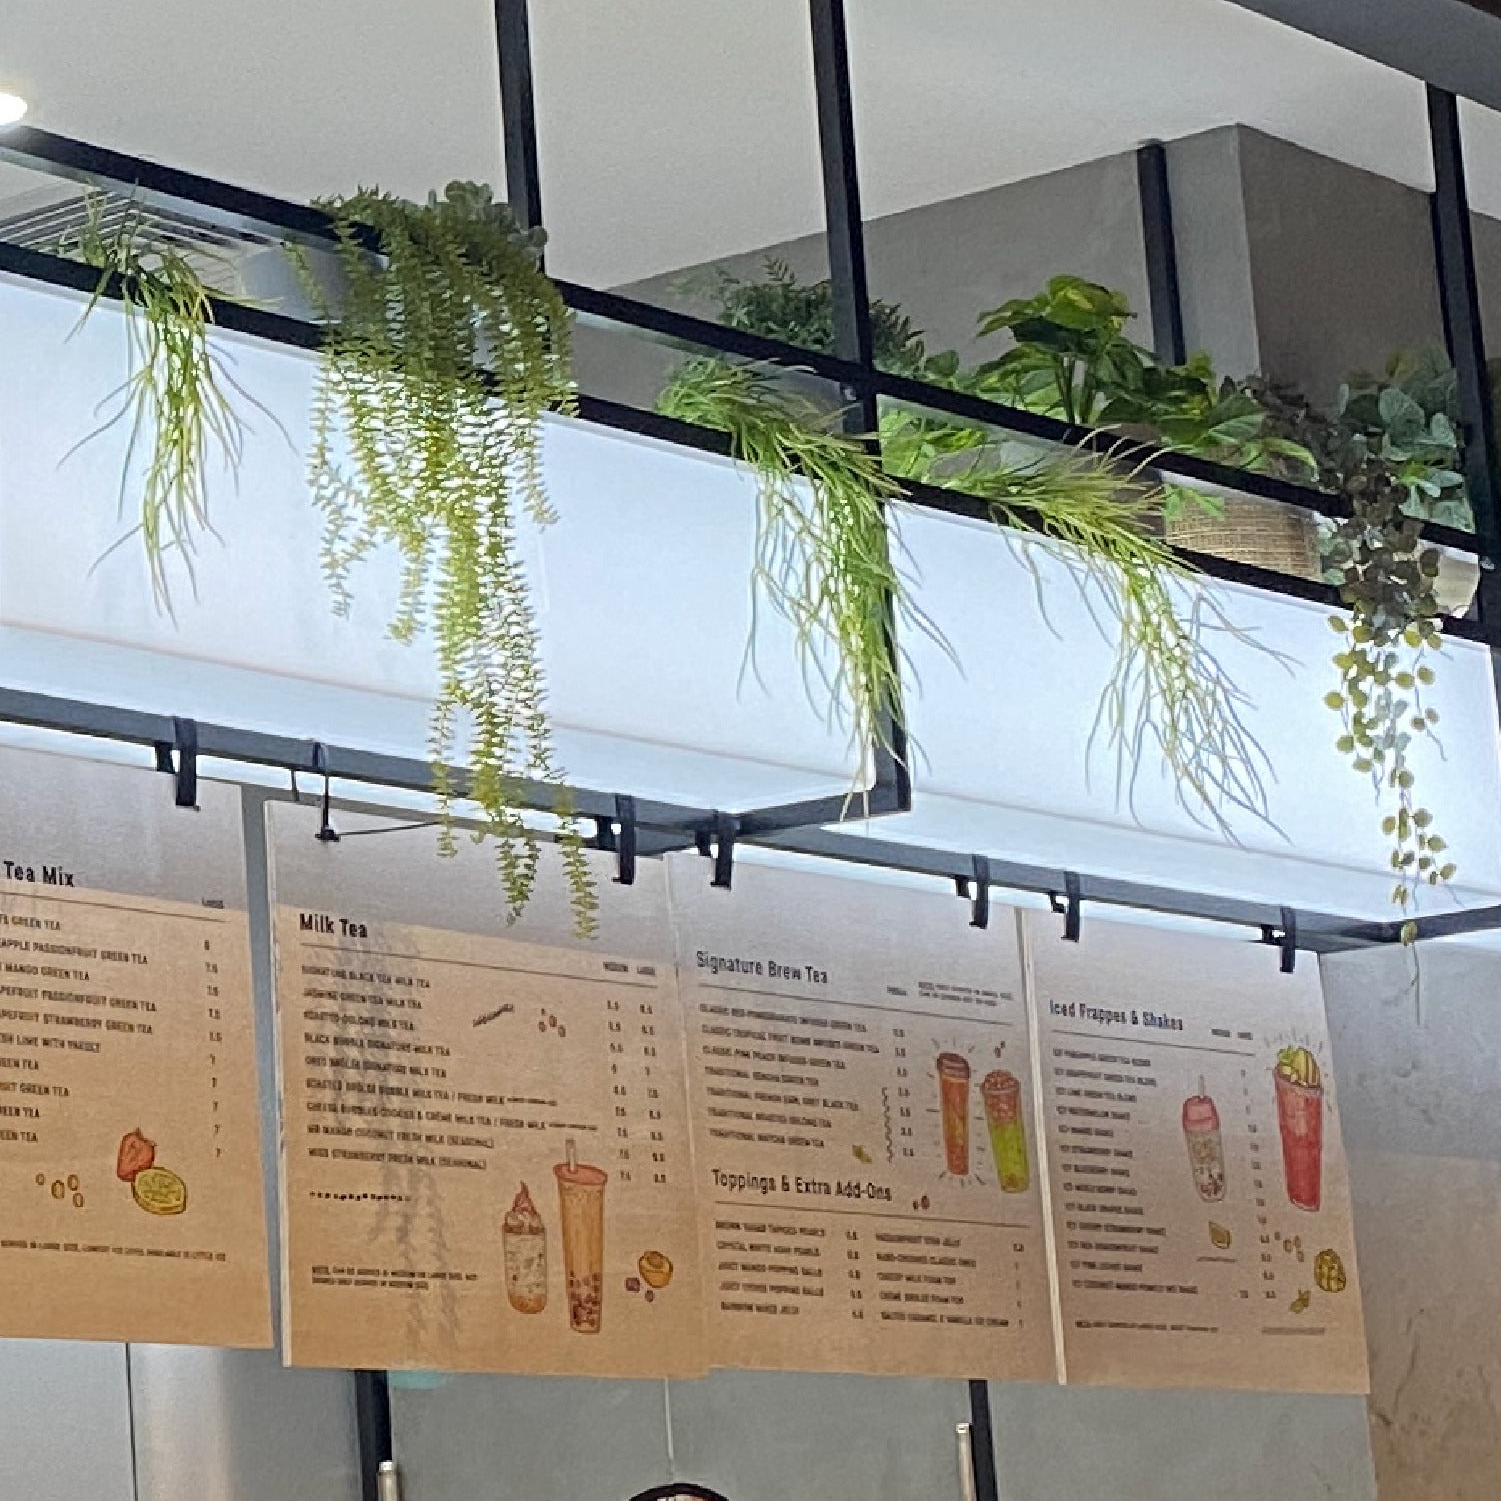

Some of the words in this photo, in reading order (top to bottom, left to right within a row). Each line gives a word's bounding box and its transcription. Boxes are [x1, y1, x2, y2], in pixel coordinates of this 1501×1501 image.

[4, 860, 35, 883] Tea
[42, 866, 75, 887] Mix
[44, 919, 61, 931] TEA
[299, 913, 334, 935] Milk
[339, 918, 368, 938] Tea
[131, 952, 148, 965] TEA
[697, 950, 763, 976] Signature
[768, 960, 801, 980] Brew
[805, 965, 828, 984] Tea
[73, 970, 90, 981] TEA
[415, 978, 430, 988] TEA
[140, 1000, 157, 1012] TEA
[1050, 1000, 1075, 1017] Iced
[1079, 1003, 1127, 1025] Frappes
[1143, 1011, 1183, 1031] Shakes
[137, 1023, 153, 1034] TEA
[22, 1059, 39, 1070] TEA
[52, 1086, 70, 1097] TEA
[23, 1107, 40, 1118] TEA
[20, 1131, 38, 1143] TEA
[711, 1169, 776, 1194] Toppings
[795, 1175, 831, 1194] Extra
[835, 1180, 892, 1201] Add-Ons
